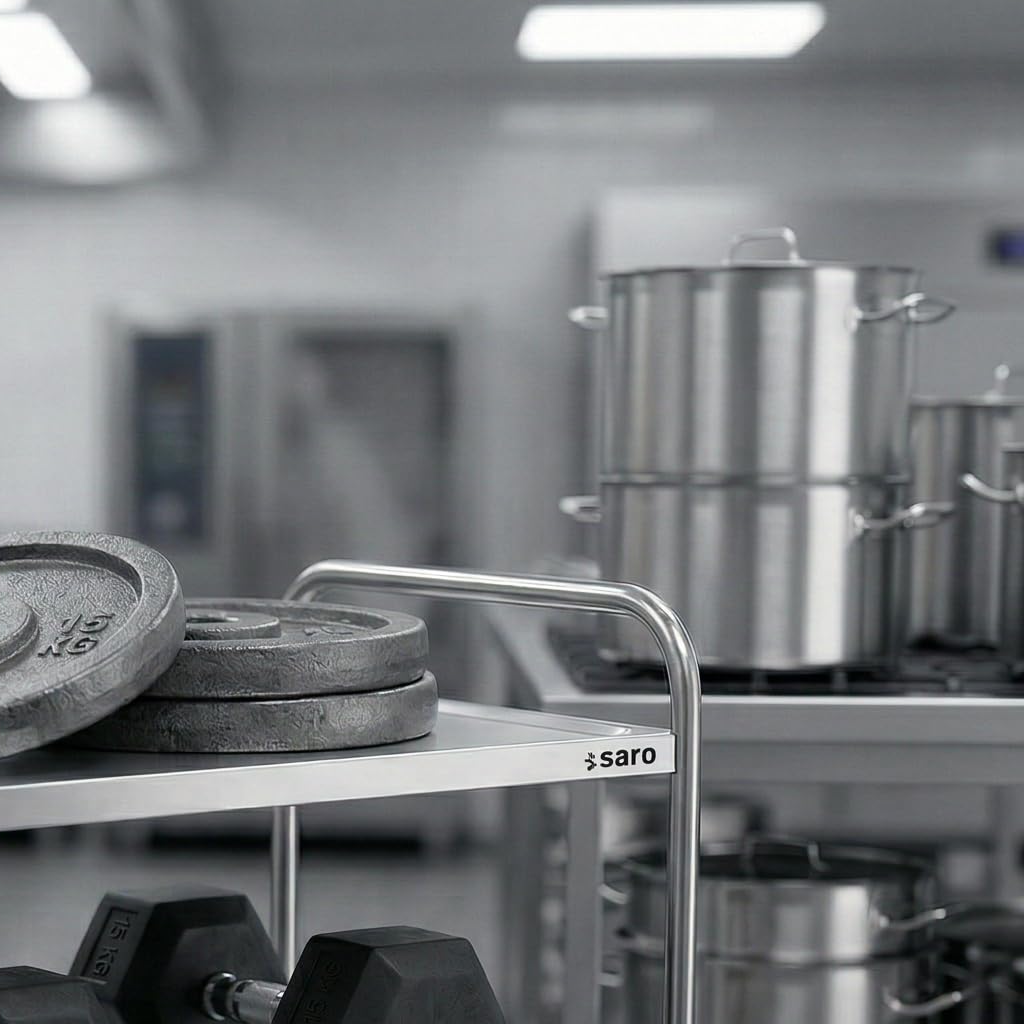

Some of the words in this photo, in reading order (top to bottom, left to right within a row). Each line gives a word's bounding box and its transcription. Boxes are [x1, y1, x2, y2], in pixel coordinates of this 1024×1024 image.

[60, 612, 116, 636] 15
[37, 636, 98, 657] KG
[600, 747, 656, 768] saro
[110, 917, 130, 940] 15
[93, 947, 118, 977] KG
